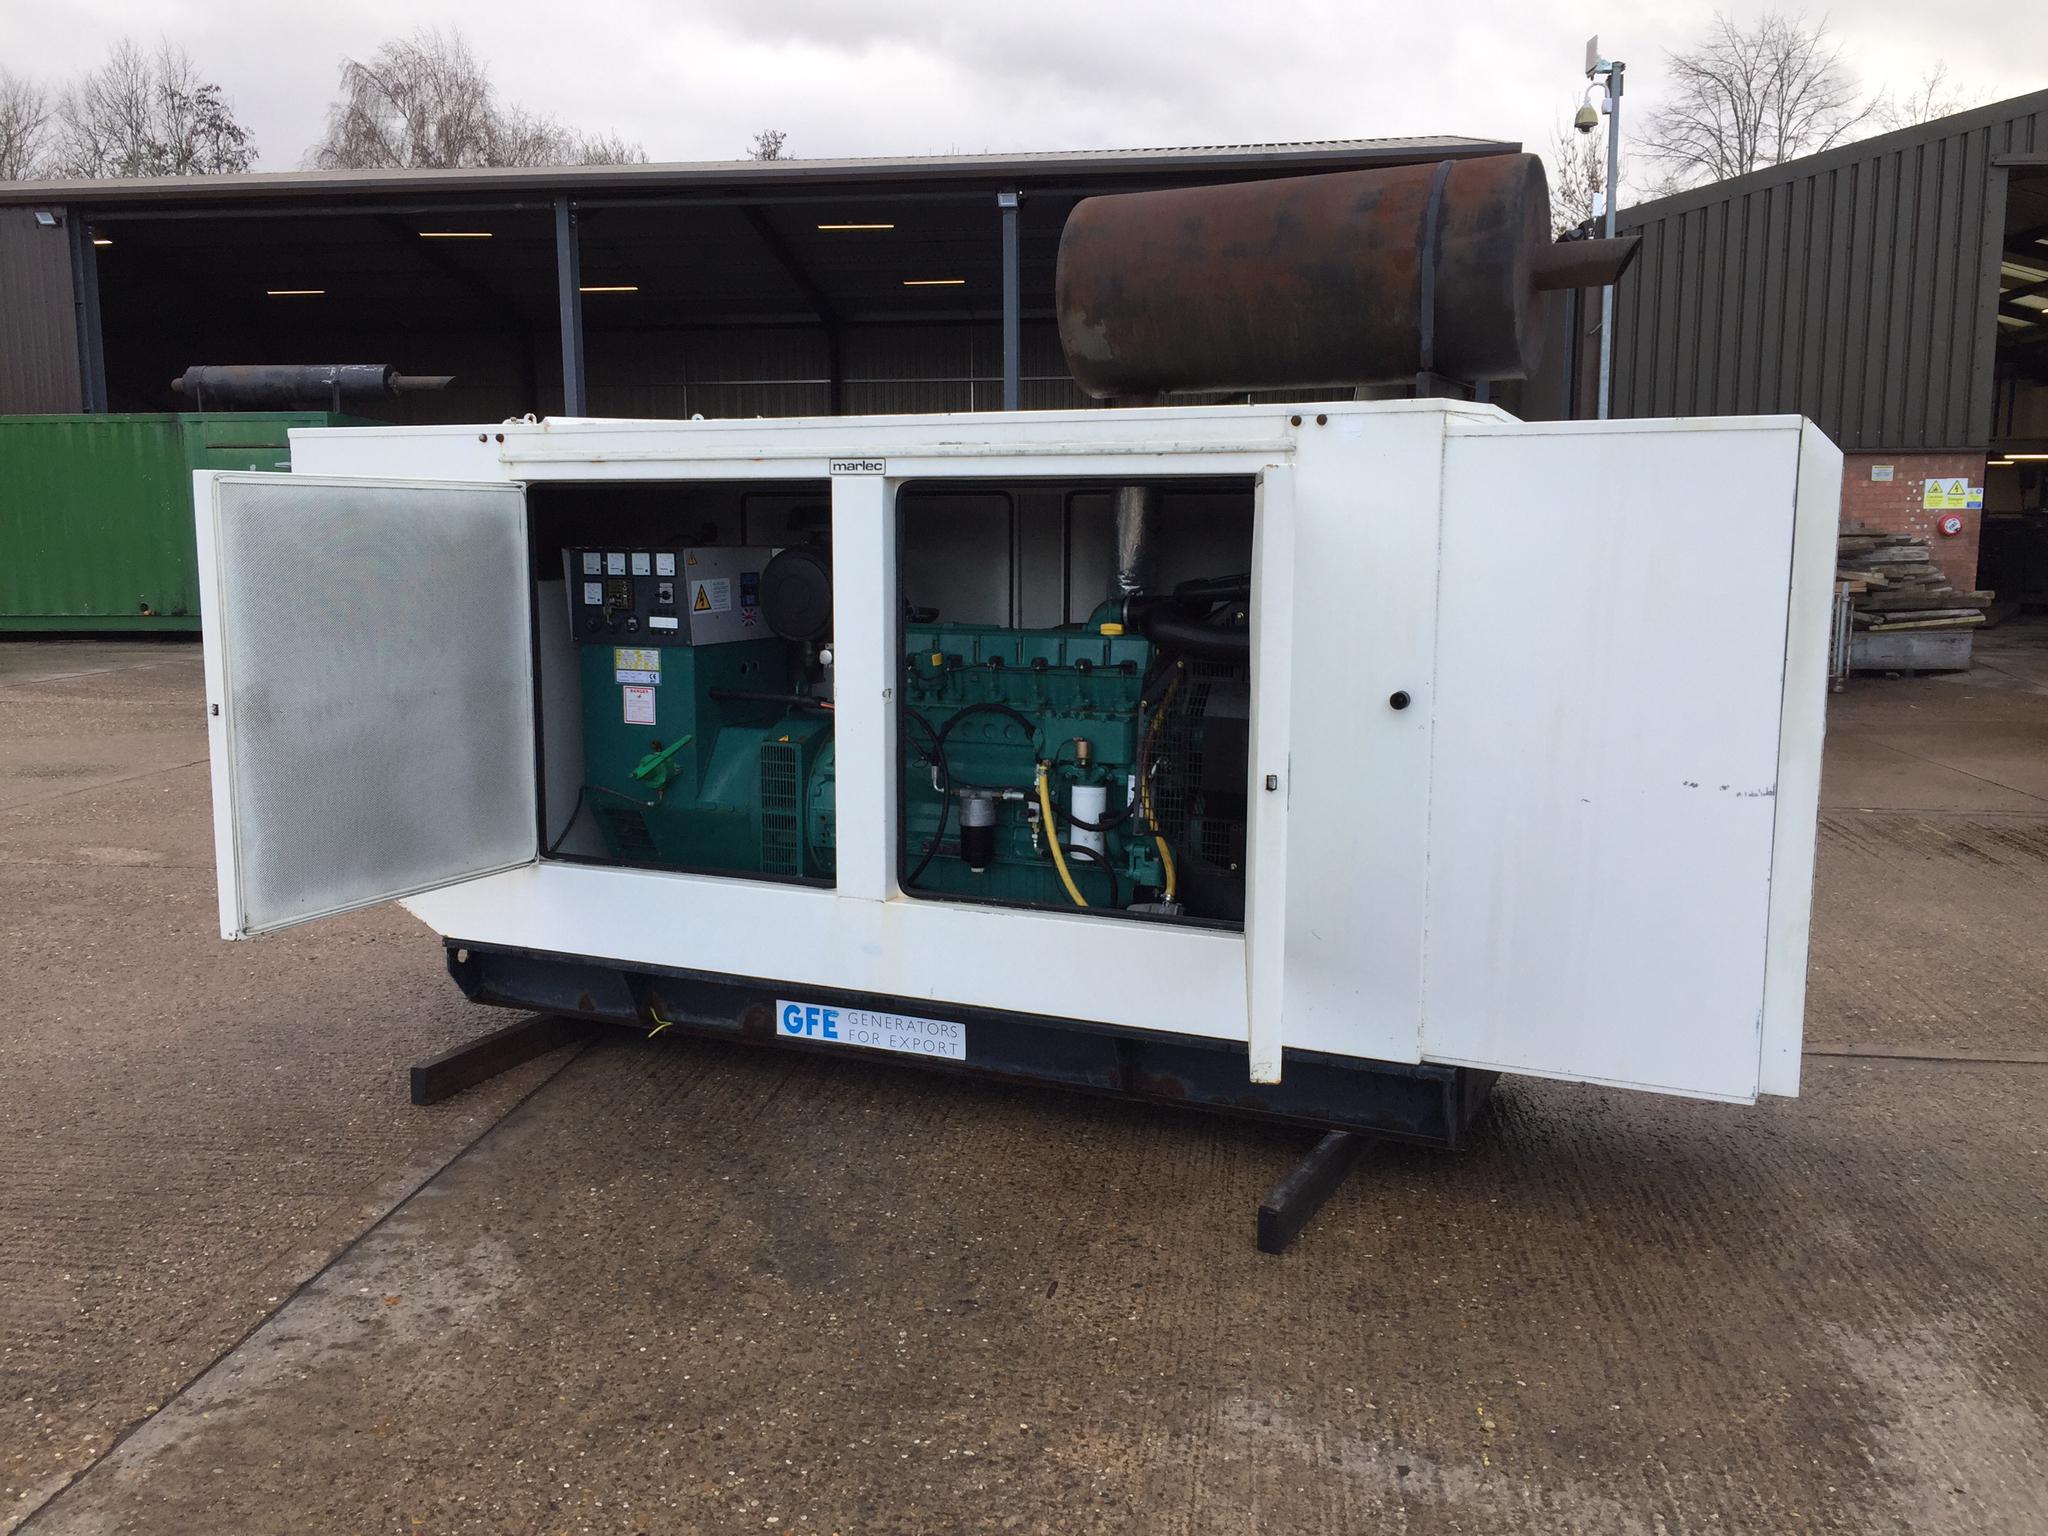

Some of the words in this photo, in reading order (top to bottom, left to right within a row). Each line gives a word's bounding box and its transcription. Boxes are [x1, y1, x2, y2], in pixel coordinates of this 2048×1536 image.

[833, 460, 883, 471] marlec
[783, 1004, 840, 1039] GFE
[847, 1012, 958, 1039] GENERATORS
[849, 1029, 880, 1045] FOR
[889, 1034, 959, 1056] EXPORT
